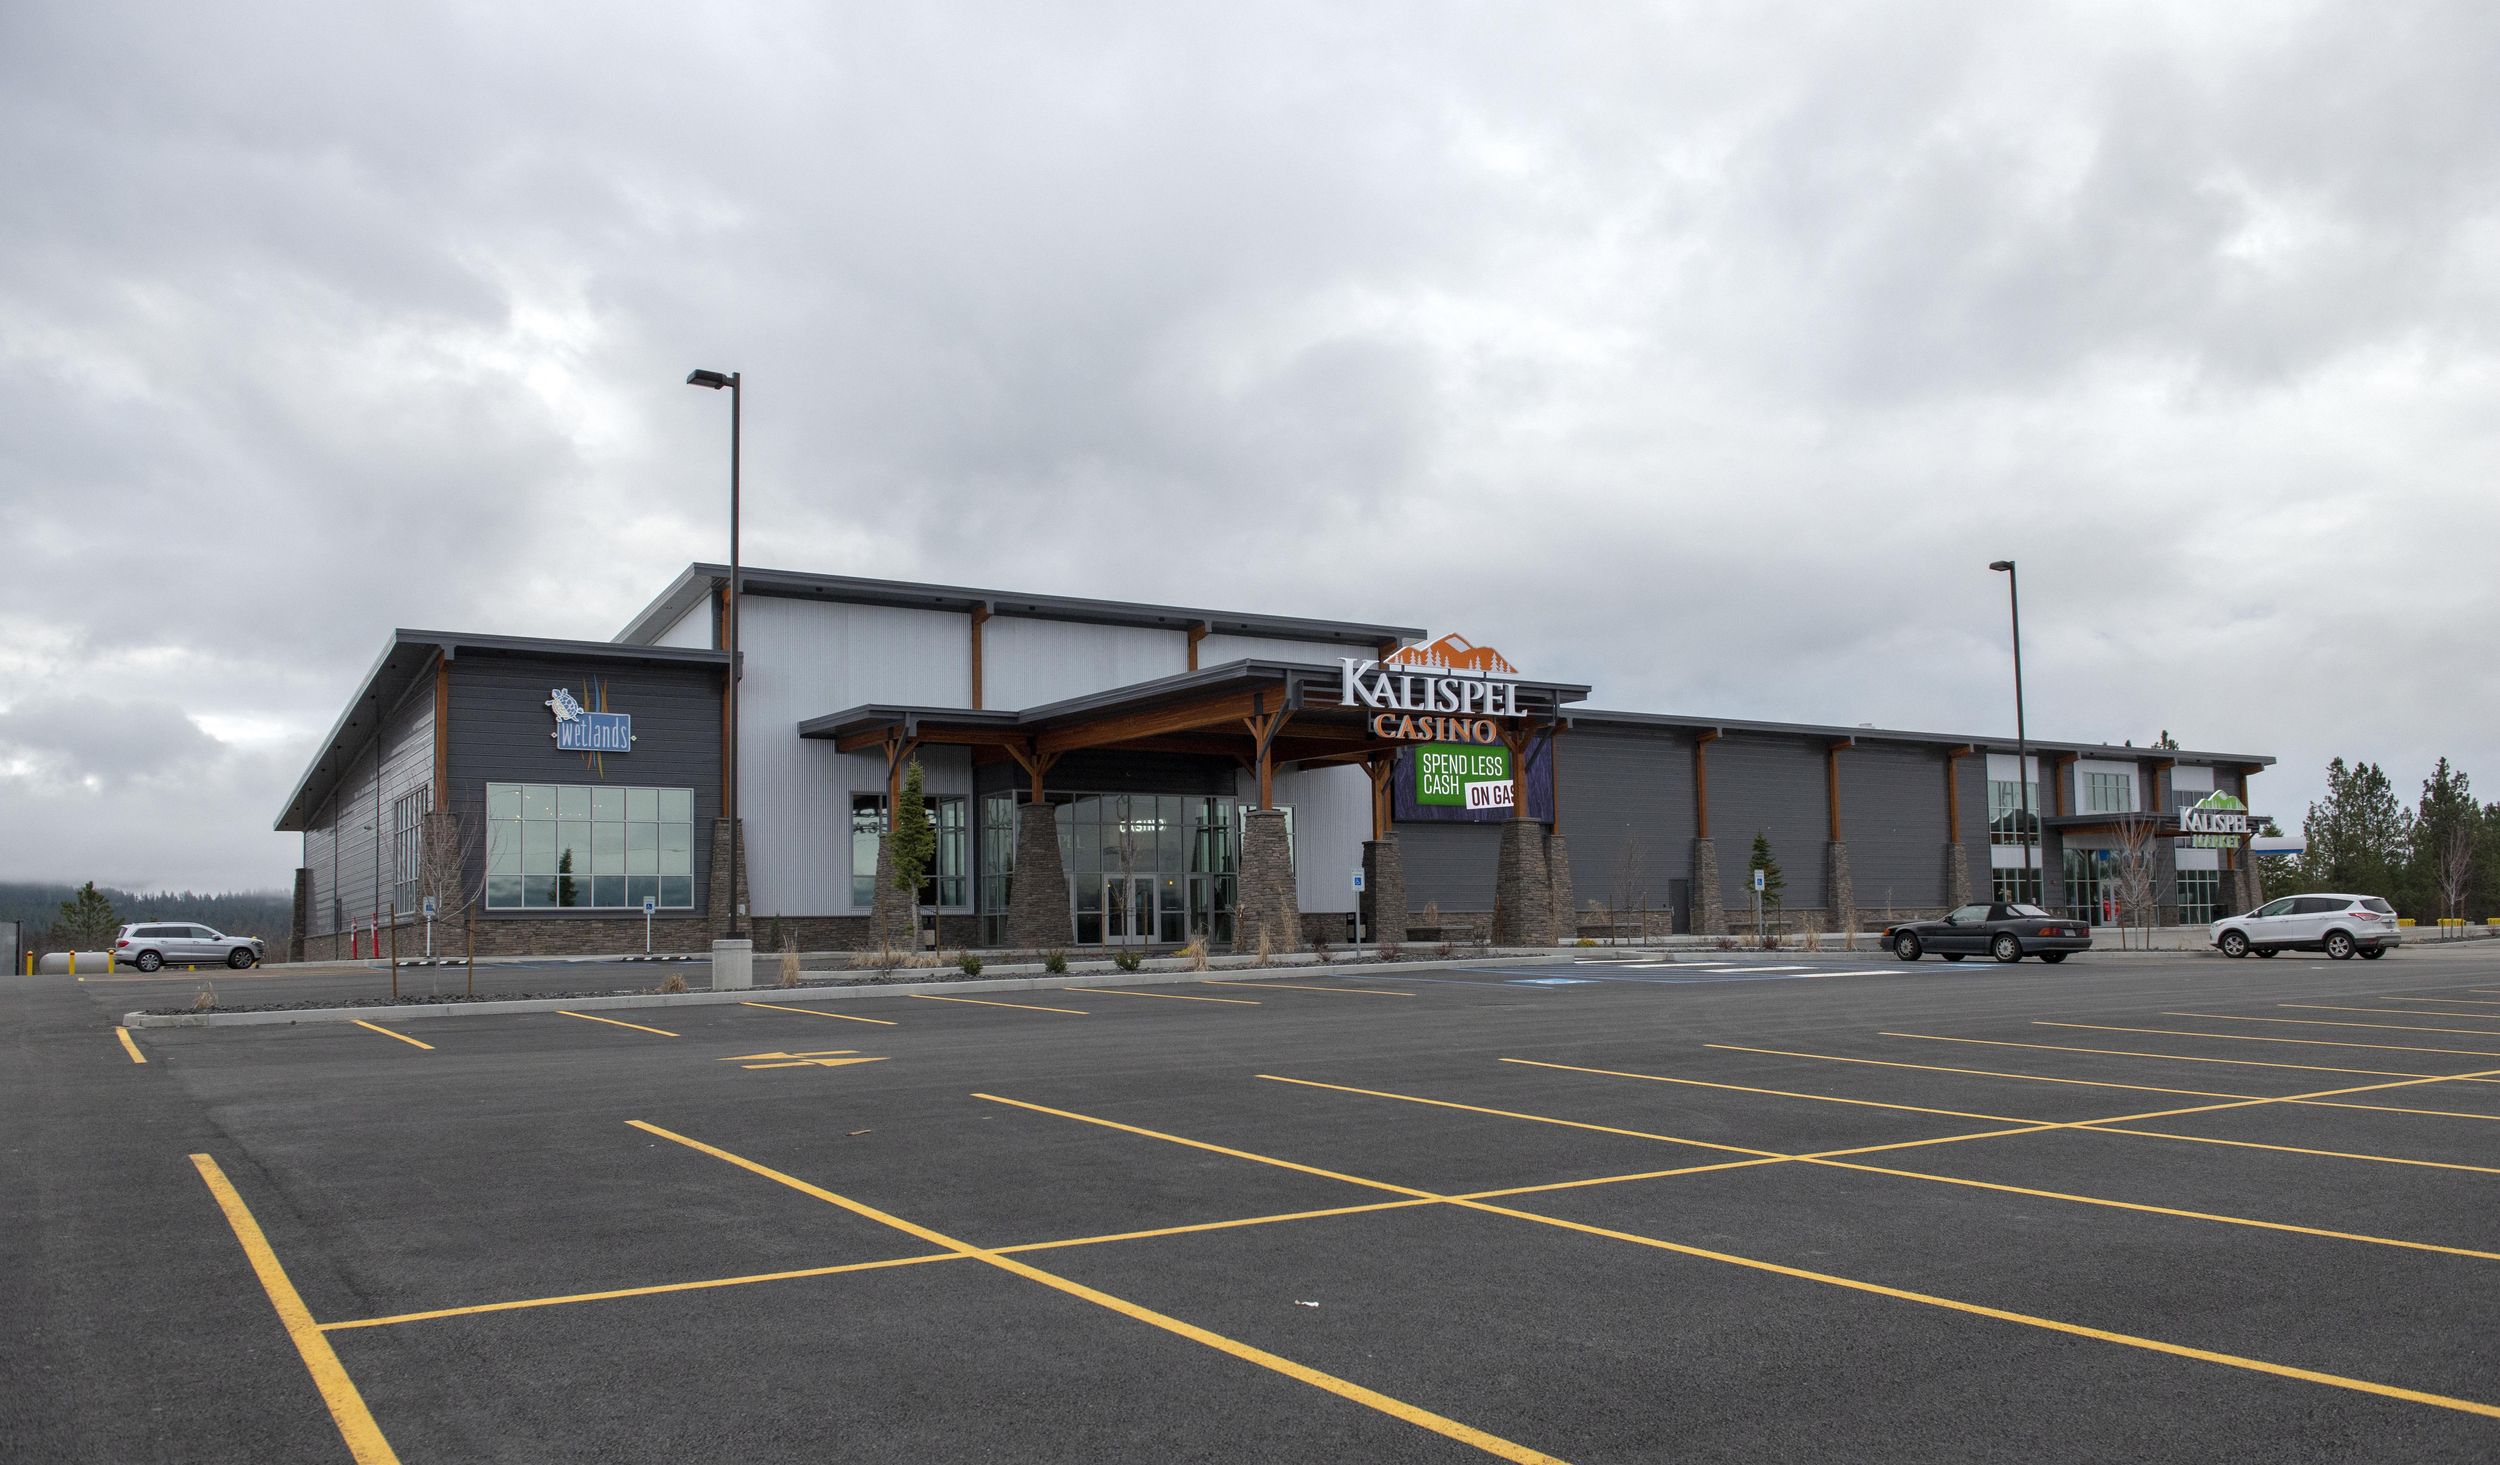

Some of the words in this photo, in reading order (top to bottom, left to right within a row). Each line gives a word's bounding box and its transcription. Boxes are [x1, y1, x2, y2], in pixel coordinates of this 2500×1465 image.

[1338, 657, 1528, 717] KALISPEL
[562, 715, 627, 748] wetlands
[1373, 713, 1497, 744] CASINO
[1423, 753, 1467, 775] SPEND
[1471, 755, 1503, 776] LESS
[1423, 774, 1459, 795] CASH
[1471, 786, 1489, 806] ON
[2178, 806, 2251, 832] KALISPEL
[2192, 834, 2240, 848] MARKET
